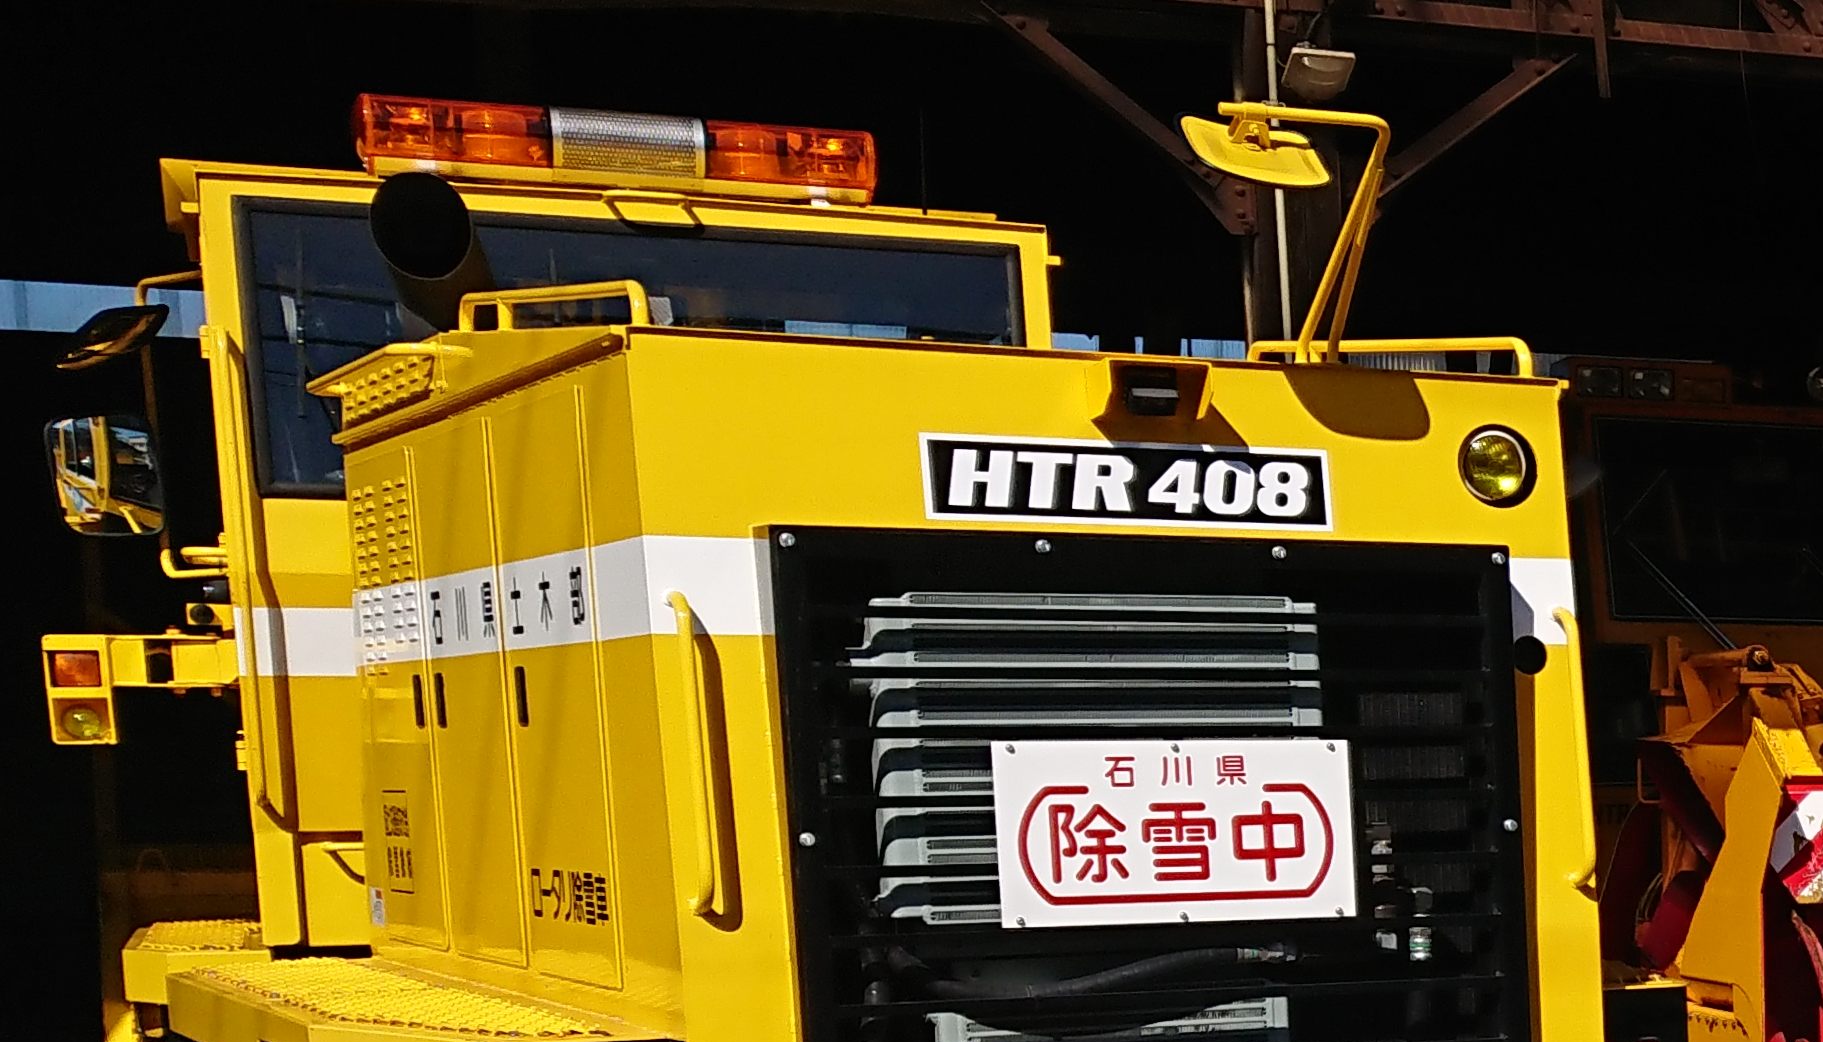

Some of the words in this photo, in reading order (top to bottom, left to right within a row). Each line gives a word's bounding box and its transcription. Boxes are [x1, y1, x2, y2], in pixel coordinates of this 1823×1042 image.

[948, 448, 1136, 513] HTR
[1148, 457, 1310, 518] 408
[1104, 755, 1248, 788] 石川県
[1048, 800, 1306, 884] 除雪中
